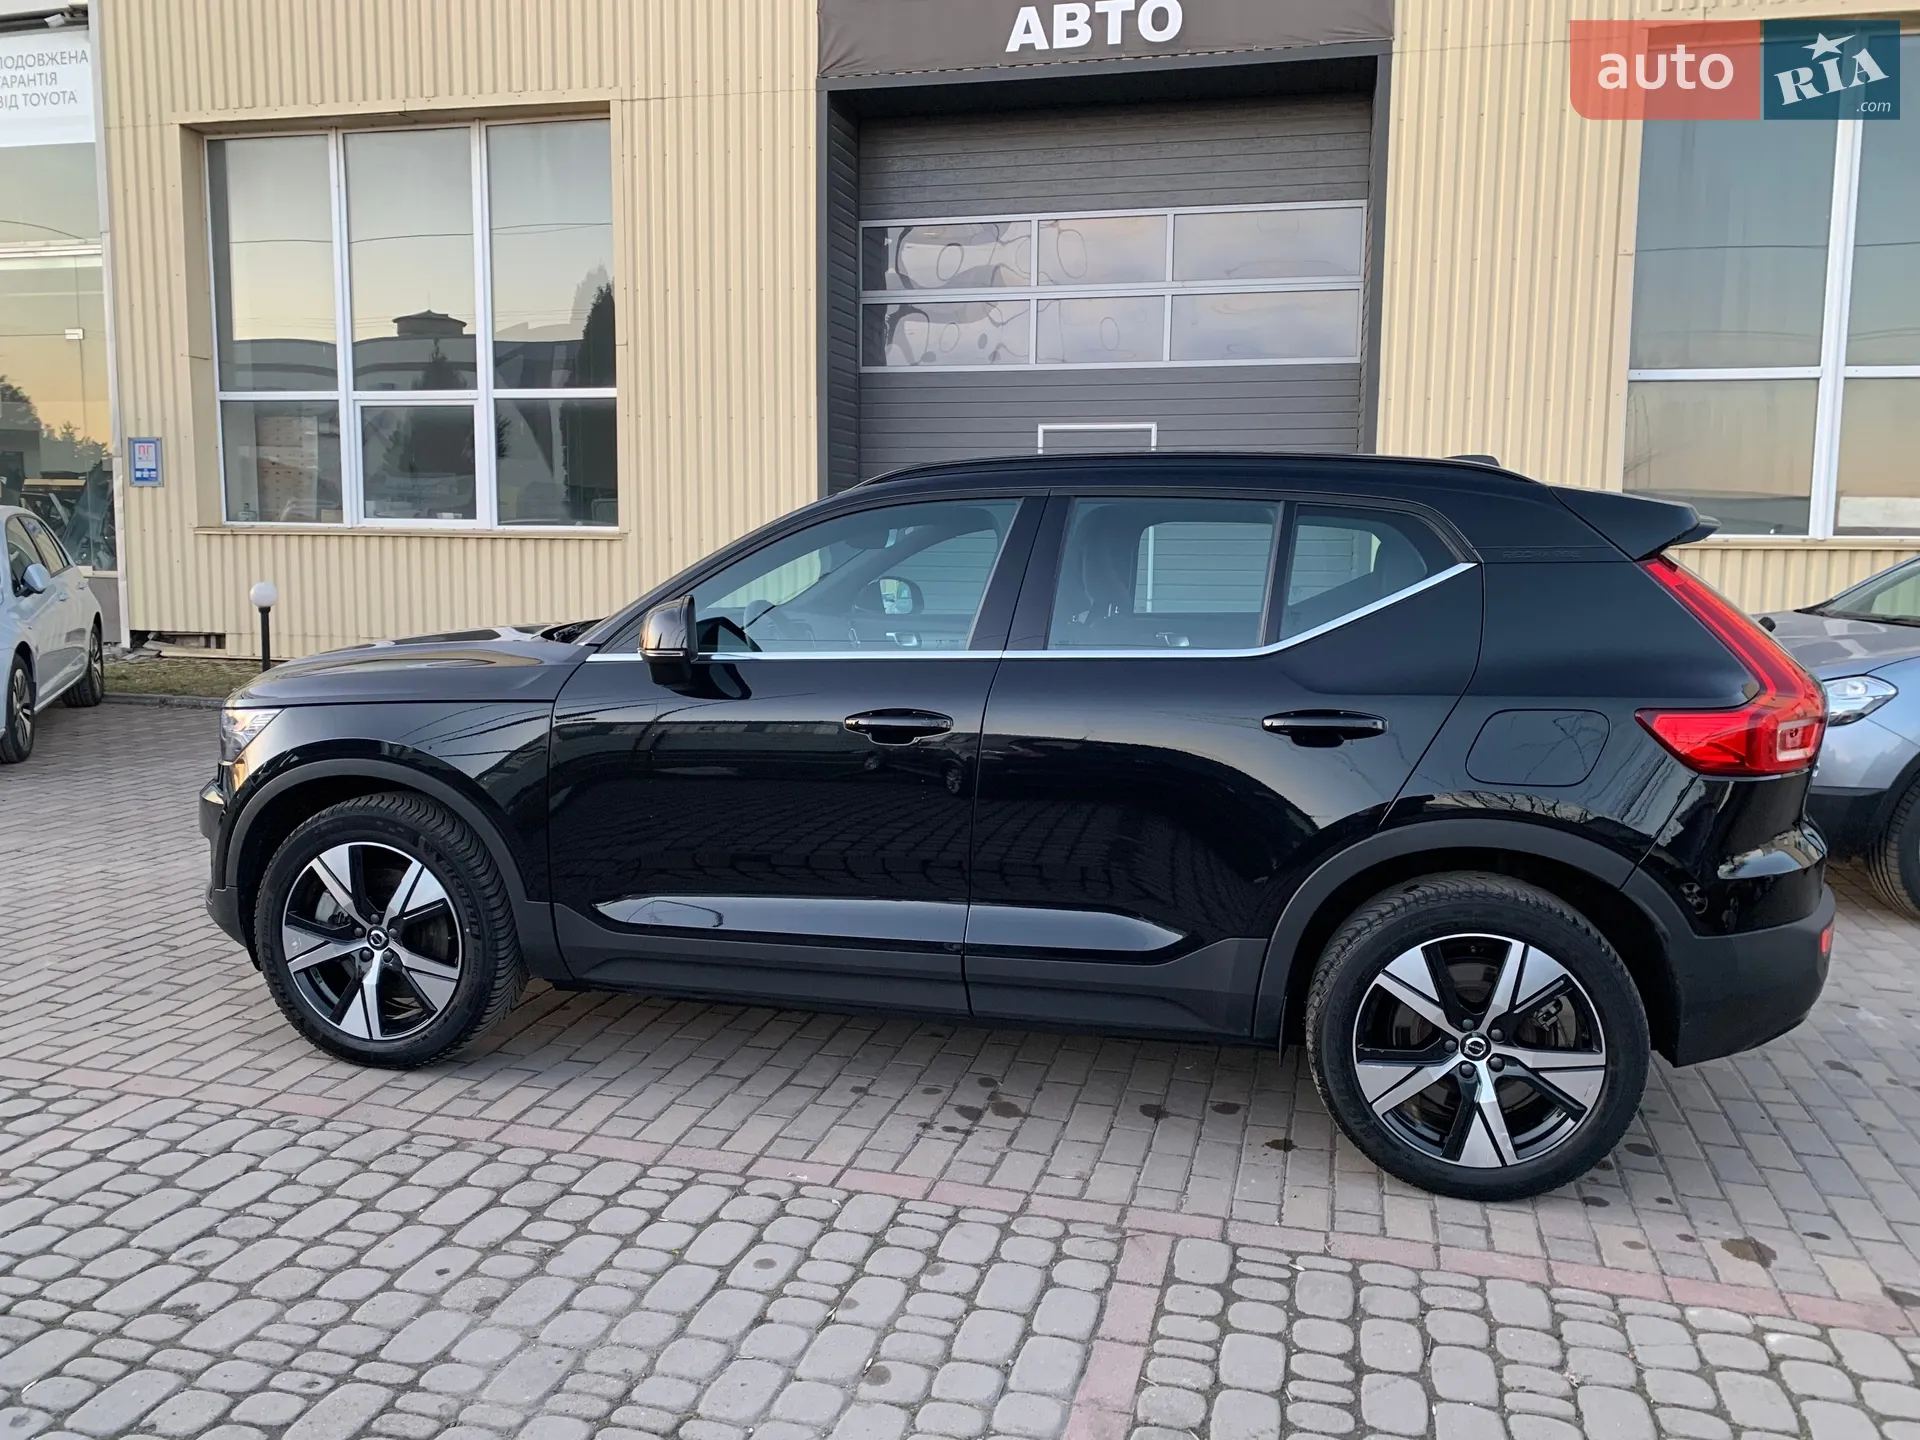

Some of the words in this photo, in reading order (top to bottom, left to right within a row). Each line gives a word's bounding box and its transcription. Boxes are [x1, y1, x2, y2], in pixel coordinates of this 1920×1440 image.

[1005, 0, 1183, 52] АВТО
[0, 72, 58, 89] АРАНТІЯ
[22, 90, 78, 107] TOYOTA
